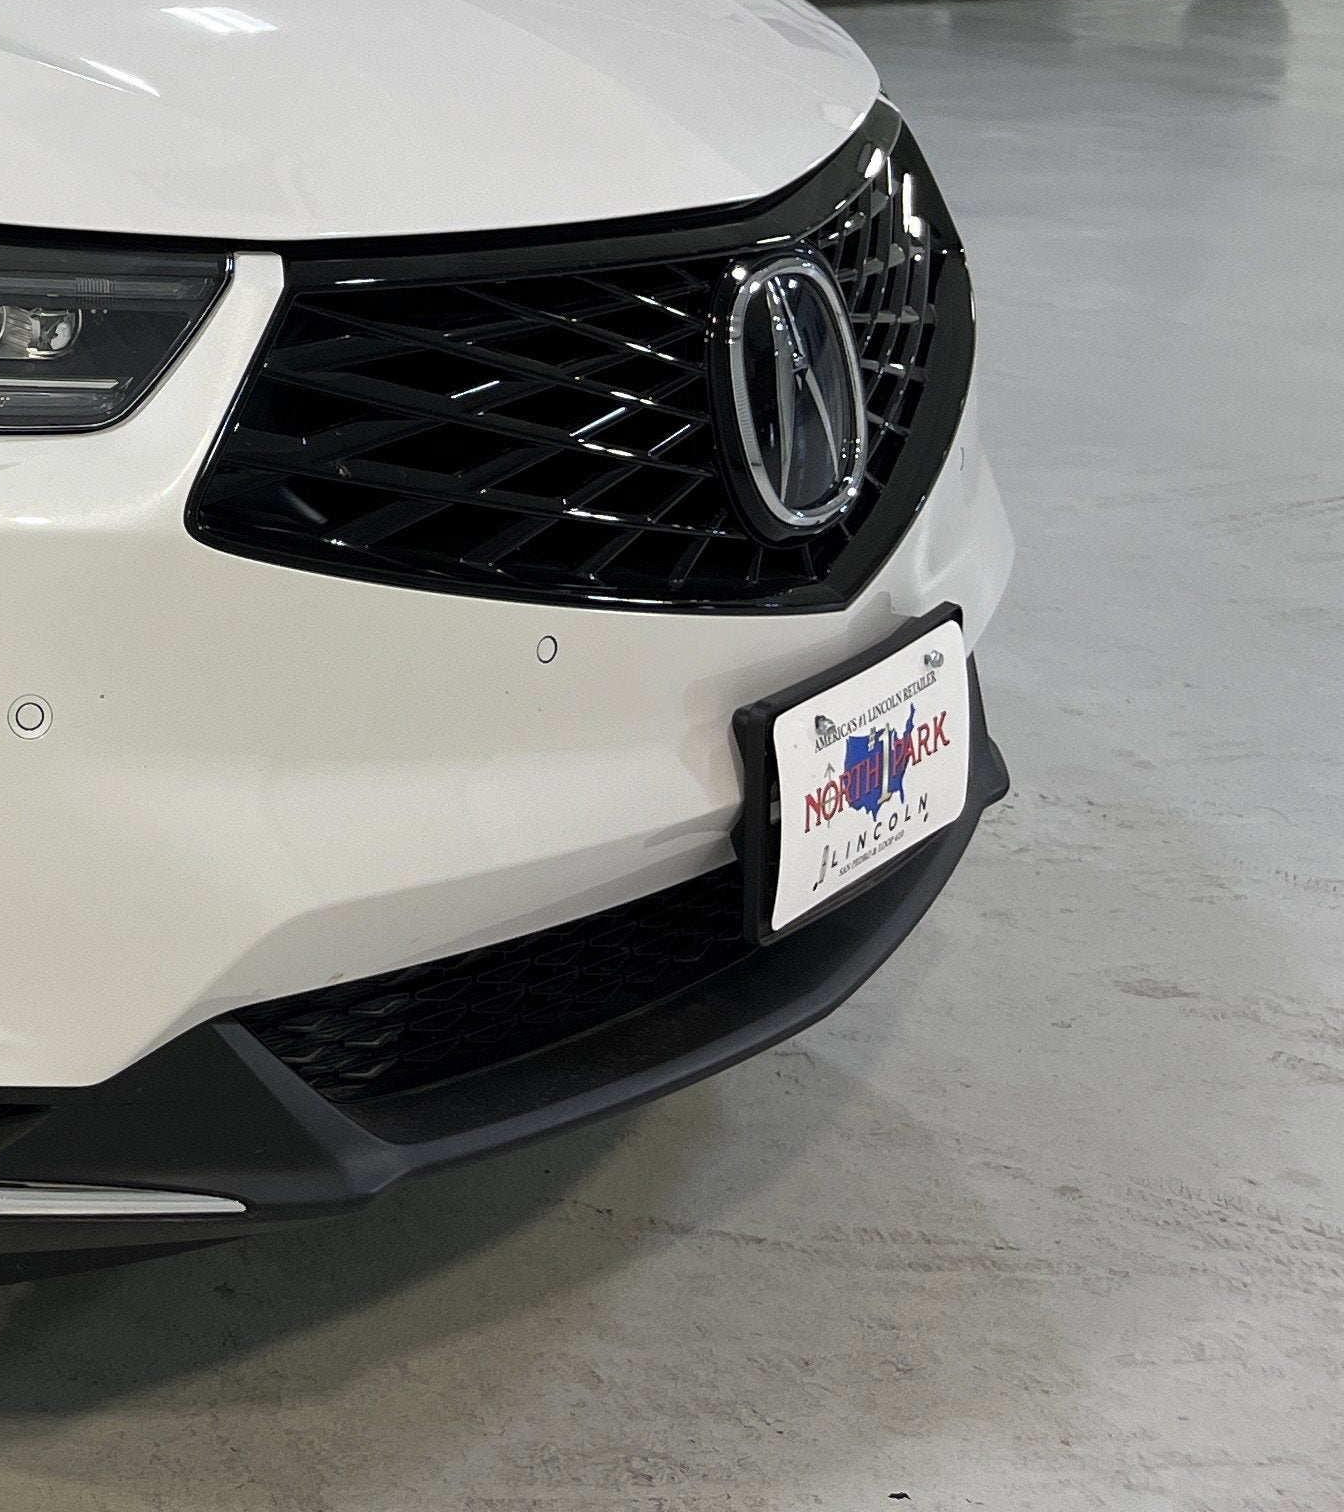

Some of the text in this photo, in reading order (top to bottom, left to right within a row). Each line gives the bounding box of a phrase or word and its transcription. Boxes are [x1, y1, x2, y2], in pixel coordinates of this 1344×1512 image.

[867, 691, 903, 722] LINCOLN
[903, 670, 937, 701] RETAILER
[804, 710, 951, 834] NORTH PARK
[830, 792, 928, 869] LINCOLN
